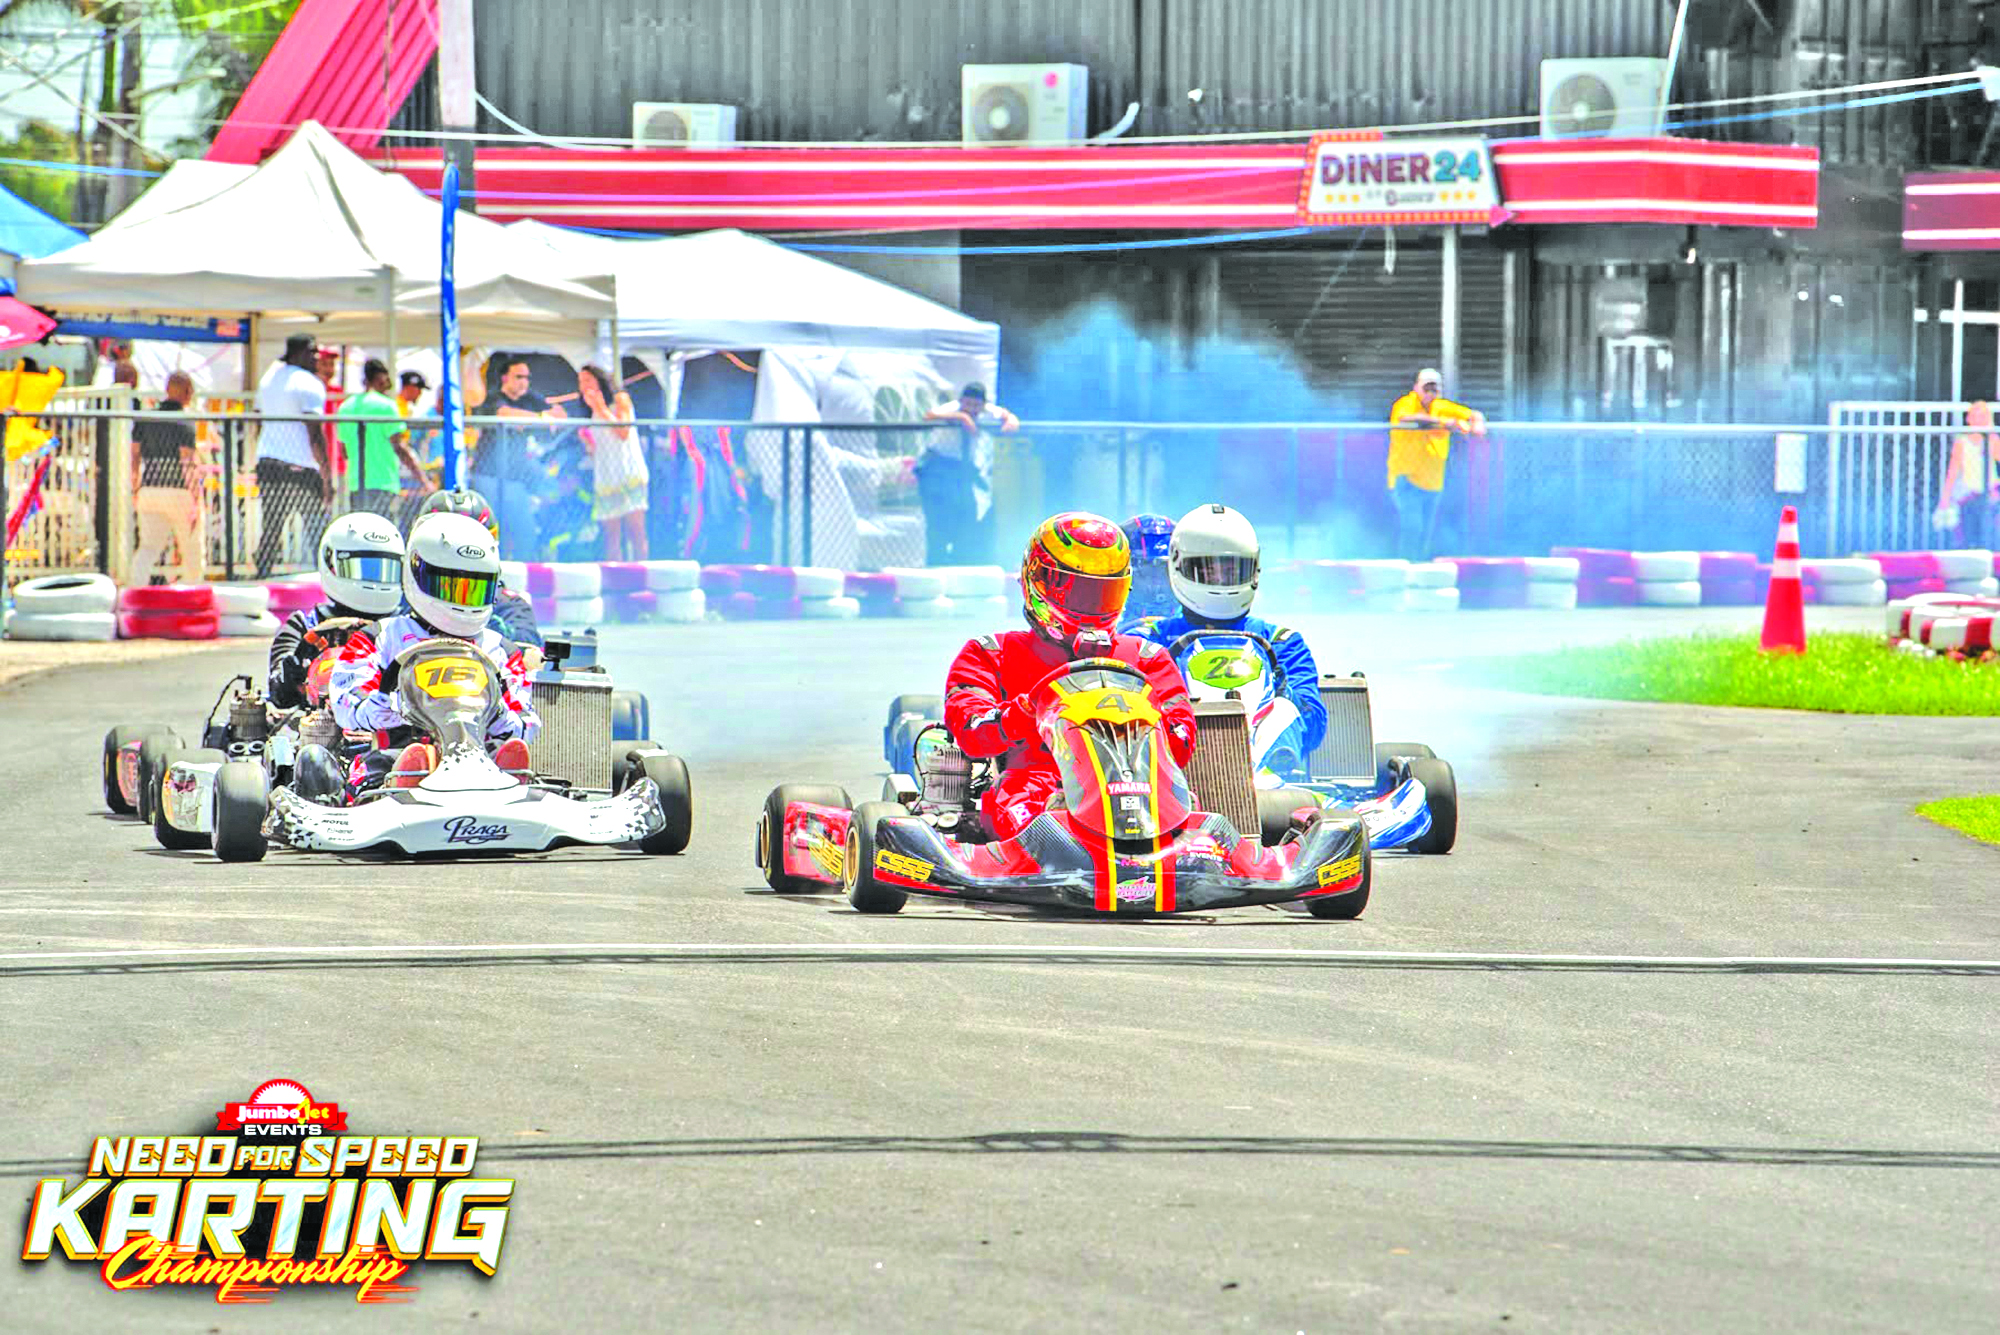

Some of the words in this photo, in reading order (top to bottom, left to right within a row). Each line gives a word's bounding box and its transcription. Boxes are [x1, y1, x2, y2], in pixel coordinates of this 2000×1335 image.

[462, 545, 484, 556] Arai
[425, 666, 478, 688] 16
[1096, 693, 1134, 714] 4
[1107, 782, 1151, 794] YAMAHA
